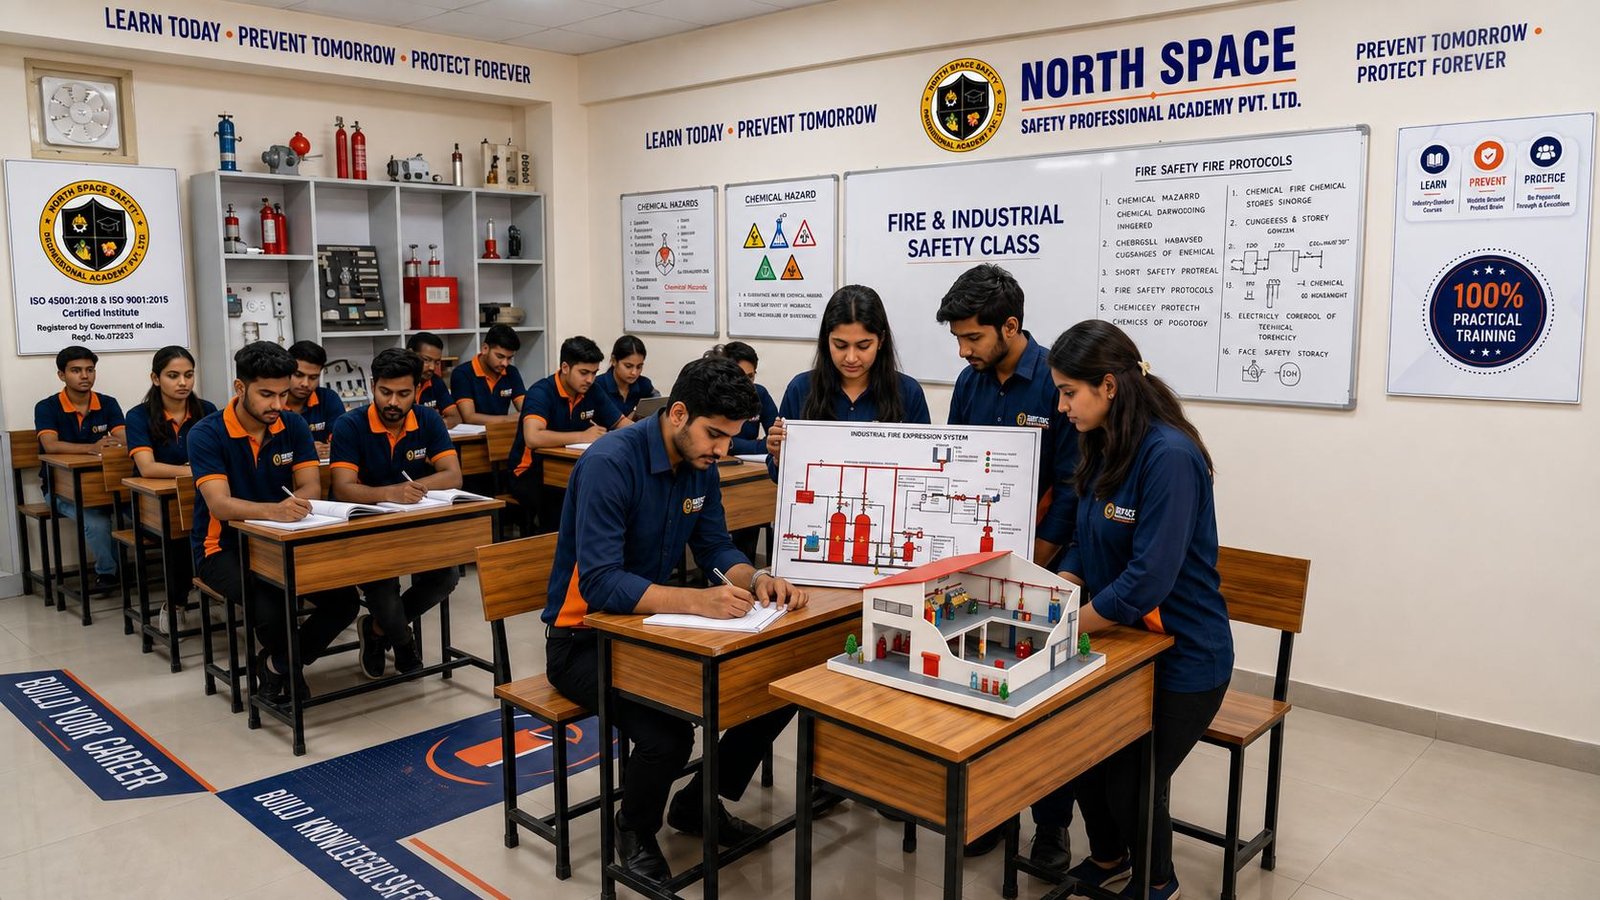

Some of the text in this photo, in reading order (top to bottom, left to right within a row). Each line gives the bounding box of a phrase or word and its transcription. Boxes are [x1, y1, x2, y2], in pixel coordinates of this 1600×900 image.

[105, 7, 531, 84] LEARN TODAY PREVENT TOMORROW PROTECT FOREVER
[1356, 23, 1528, 60] PREVENT TOMORROW
[1021, 26, 1296, 102] NORTH SPACE
[1357, 51, 1506, 83] PROTECT FOREVER
[1021, 108, 1065, 134] SAFETY
[1070, 102, 1164, 130] PROFESSIONAL
[1168, 97, 1234, 120] ACADEMY
[1238, 93, 1268, 113] PVT.
[1272, 91, 1302, 110] LTD.
[646, 104, 877, 150] LEARN TODAY PREVENT TOMORROW
[1135, 155, 1292, 177] FIRE SAFETY FIRE PROTOCOLS
[1421, 180, 1447, 190] LEARN
[1470, 176, 1506, 187] PREVENT
[1246, 187, 1283, 196] CHEMICAL
[1309, 182, 1346, 191] CHEMICAL
[48, 188, 75, 214] NORTH
[77, 184, 107, 193] SPACE
[745, 190, 816, 204] CHEMICAL HAZARD
[1117, 196, 1156, 204] CHEMICAL
[638, 199, 698, 211] CHEMICAL HAZARDS
[1246, 200, 1273, 208] STORES
[888, 204, 1064, 232] FIRE & INDUSTRIAL
[1117, 210, 1152, 218] CHEMICAL
[1302, 214, 1329, 222] STOREY
[908, 234, 1040, 257] SAFETY CLASS
[1179, 248, 1215, 256] ENEMICAL
[1147, 268, 1175, 276] SAFETY
[1181, 267, 1219, 275] PROTREAL
[30, 297, 46, 305] ISO
[109, 296, 124, 304] ISO
[126, 295, 169, 304] 9001:2015
[1454, 282, 1524, 309] 100%
[62, 308, 139, 317] Certified Institute
[1453, 313, 1522, 326] PRACTICAL
[37, 324, 77, 332] Registered
[1456, 330, 1516, 342] TRAINING
[1298, 350, 1328, 358] STORACY
[15, 675, 168, 791] BUILD YOUR CAREER
[253, 788, 314, 821] BUILD
